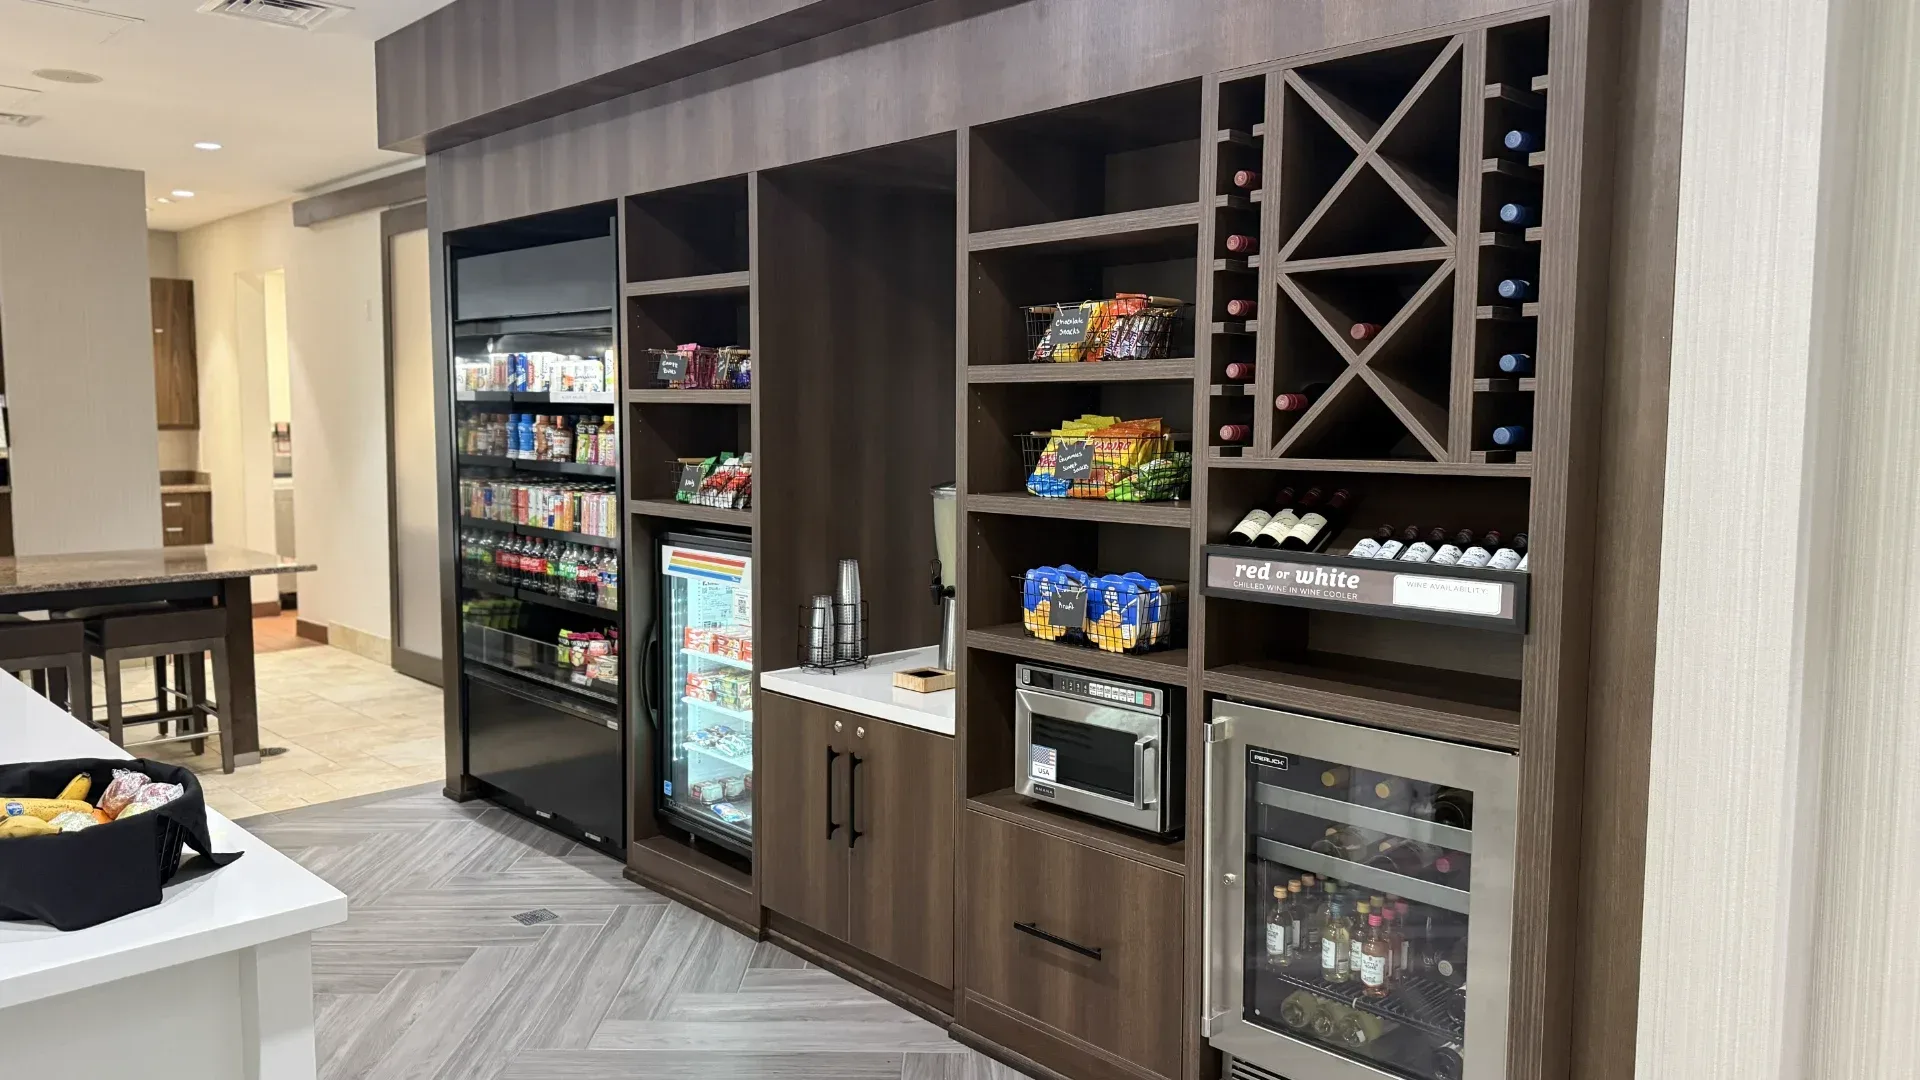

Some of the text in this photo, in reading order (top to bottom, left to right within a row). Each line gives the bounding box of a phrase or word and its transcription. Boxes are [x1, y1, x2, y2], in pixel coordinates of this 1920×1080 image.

[1235, 562, 1360, 589] red or white
[1233, 581, 1358, 600] CHILLED WINE IN WINE COOLER
[1406, 581, 1489, 595] WINE AVAILABILITY:
[1037, 767, 1050, 776] USA
